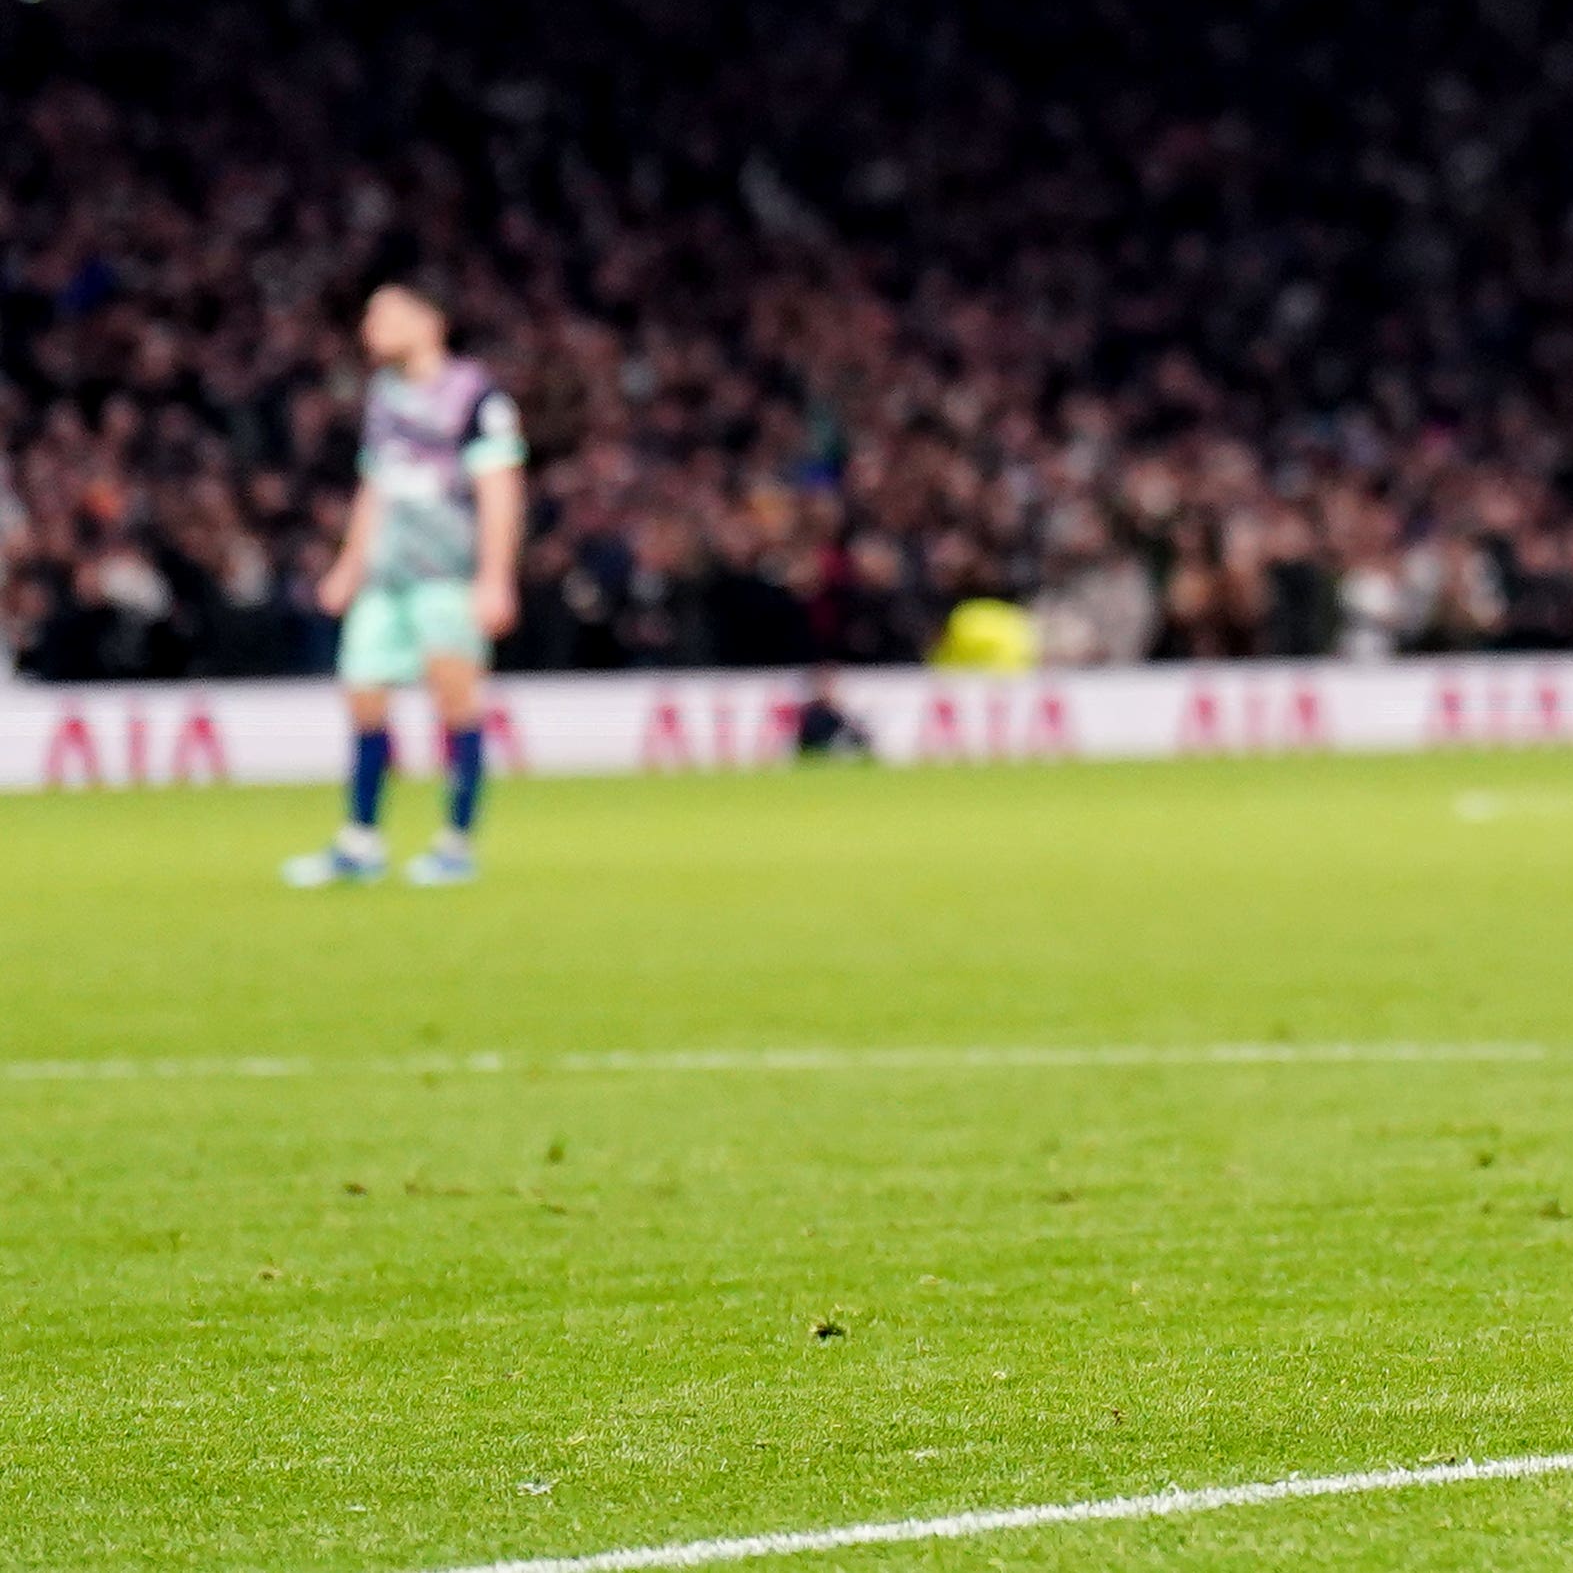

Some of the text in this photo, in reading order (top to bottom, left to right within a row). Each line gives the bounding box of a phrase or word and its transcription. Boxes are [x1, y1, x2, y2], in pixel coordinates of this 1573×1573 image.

[40, 691, 230, 785] AIA
[916, 675, 1081, 761] AIA
[1174, 669, 1336, 757] AIA
